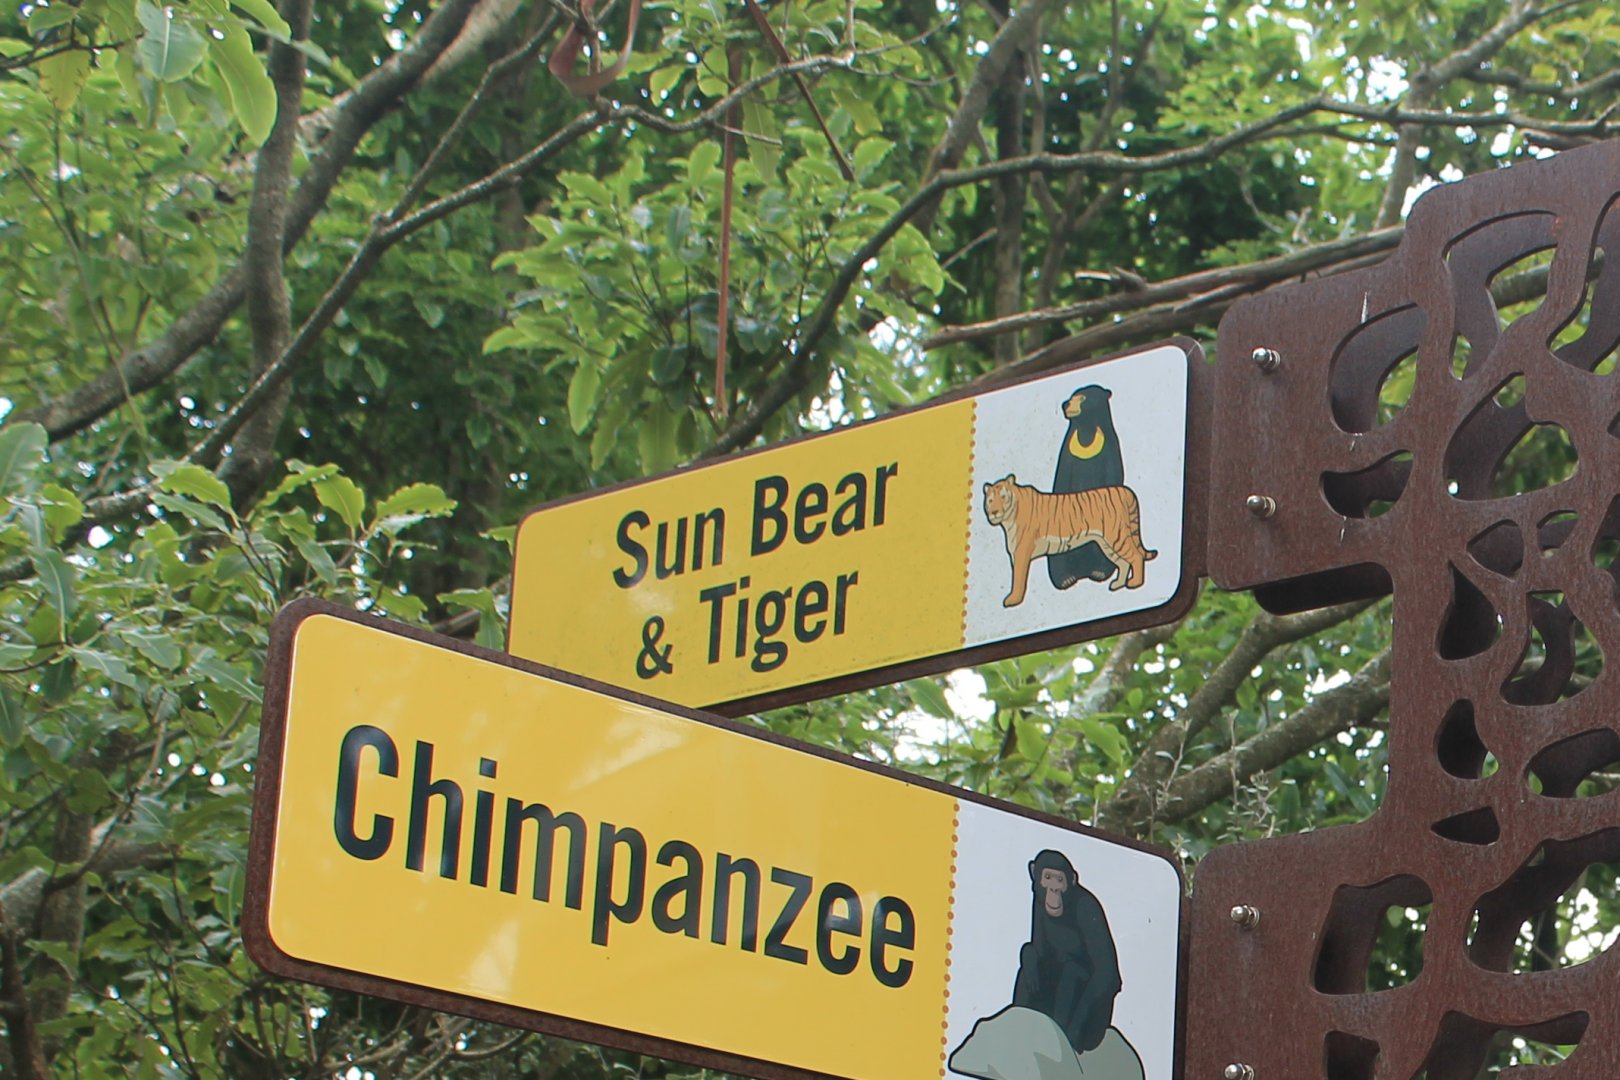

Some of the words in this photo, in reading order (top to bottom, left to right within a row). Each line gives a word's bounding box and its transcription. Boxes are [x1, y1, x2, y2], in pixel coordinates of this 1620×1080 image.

[612, 506, 725, 590] Sun
[750, 462, 898, 558] Bear
[635, 615, 674, 680] &
[699, 570, 859, 673] Tiger
[334, 724, 915, 989] Chimpanzee
